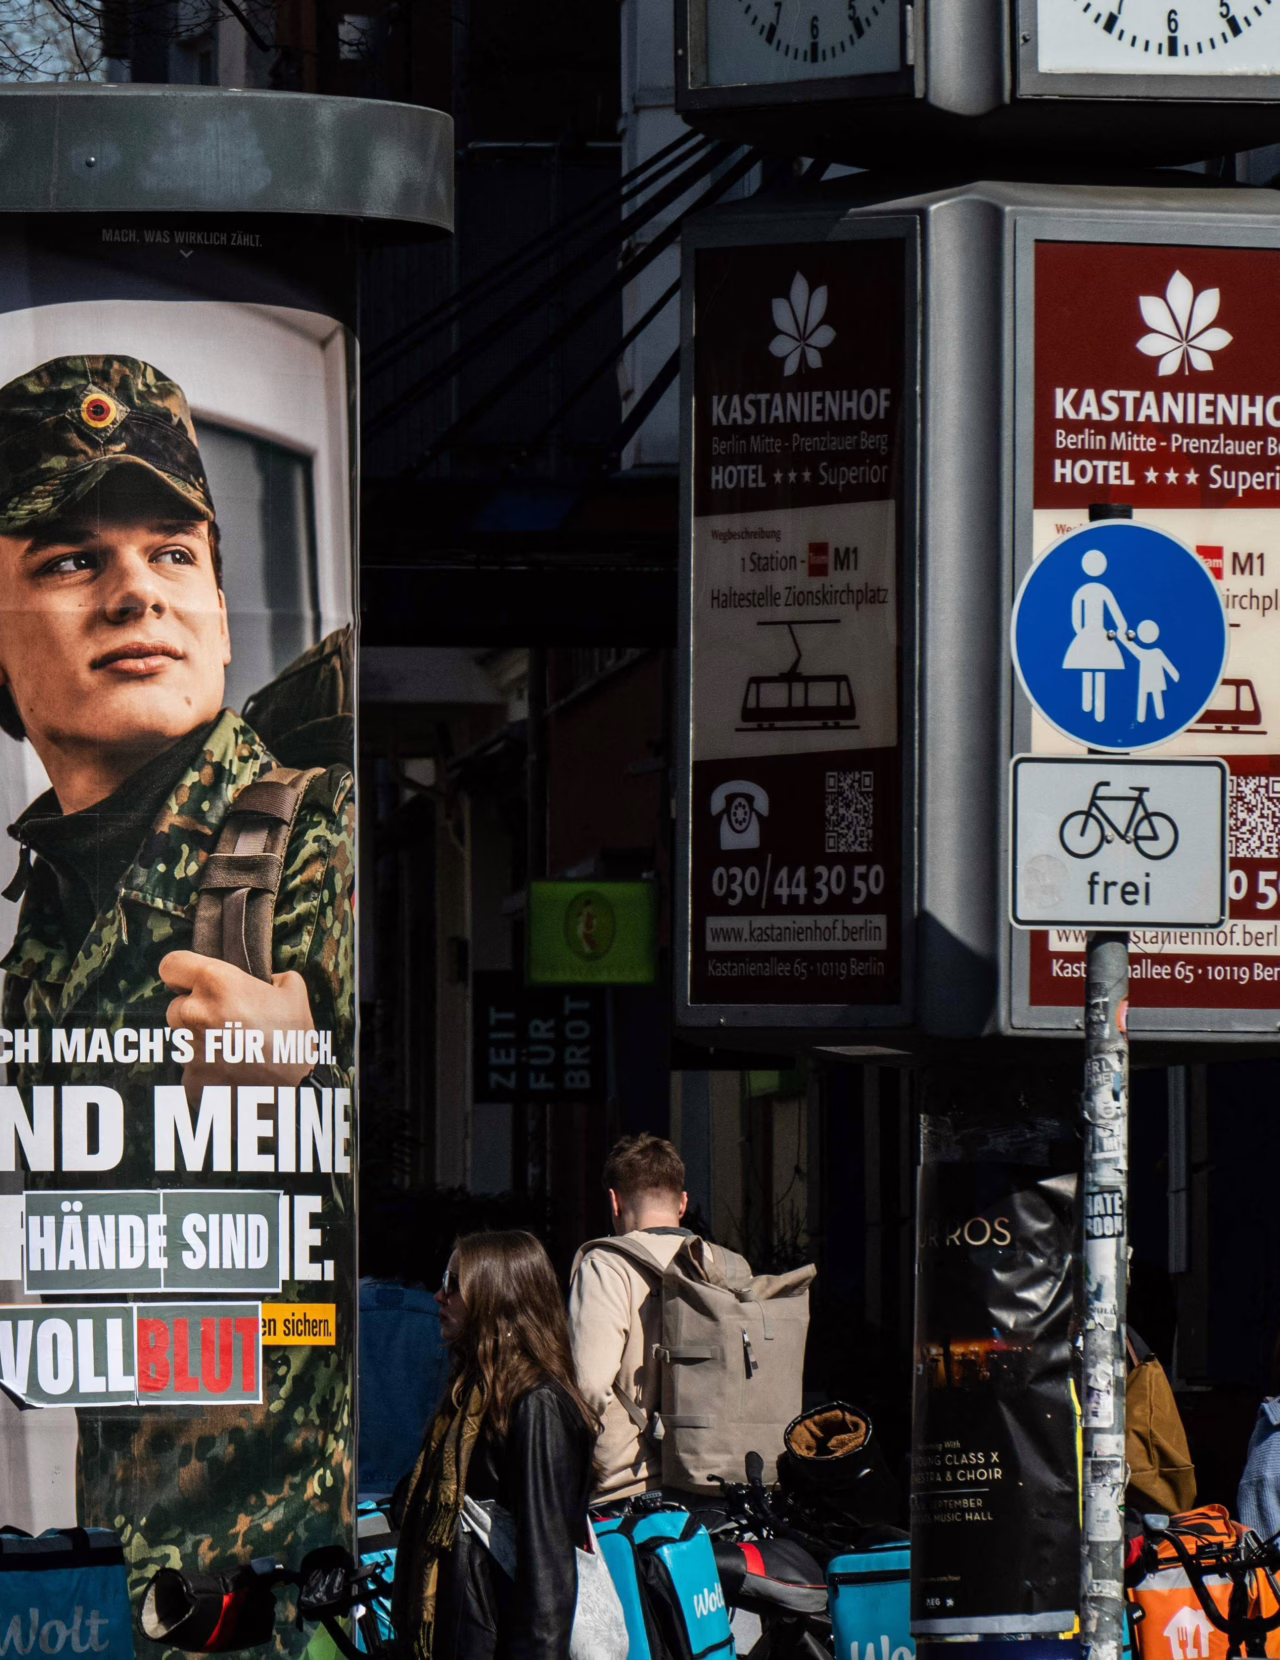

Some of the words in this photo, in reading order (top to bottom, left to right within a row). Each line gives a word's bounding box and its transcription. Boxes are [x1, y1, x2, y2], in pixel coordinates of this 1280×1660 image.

[1167, 9, 1179, 34] 6
[144, 229, 170, 244] WAS
[174, 230, 227, 246] WIRKLICH
[231, 230, 263, 248] ZÄHLT.
[711, 387, 892, 427] KASTANIENHOF
[711, 434, 747, 456] Berlin
[749, 433, 782, 454] Mitte
[792, 430, 858, 452] Prenzlauer
[860, 430, 889, 456] Berg
[1055, 428, 1107, 450] Berlin
[1110, 431, 1157, 452] Mitte
[1171, 432, 1264, 455] Prenzlauer
[710, 463, 766, 490] HOTEL
[818, 459, 889, 492] Superior
[1054, 458, 1136, 486] HOTEL
[749, 550, 797, 573] Station
[834, 546, 859, 571] M1
[1231, 551, 1265, 577] M1
[710, 584, 782, 609] Haltestelle
[784, 582, 889, 612] Zionskirchplatz
[813, 864, 847, 905] 30
[852, 863, 886, 905] 50
[1087, 871, 1151, 906] frei
[709, 918, 883, 943] www.kastanienhof.berlin
[708, 956, 792, 977] Kastanienallee
[793, 957, 808, 981] 65
[817, 961, 847, 981] 10119
[850, 956, 886, 977] Berlin
[1175, 961, 1195, 984] 65
[1206, 966, 1250, 985] 10119
[51, 1028, 195, 1064] MACH'S
[205, 1021, 265, 1064] FÜR
[272, 1029, 337, 1065] MICH.
[489, 1005, 517, 1091] ZEIT
[521, 1016, 556, 1091] FÜR
[563, 994, 593, 1090] BROT
[154, 1085, 351, 1174] MEINE
[27, 1200, 168, 1271] HÄNDE
[181, 1212, 269, 1271] SIND
[283, 1312, 333, 1338] sichern.
[945, 1451, 986, 1467] CLASS
[991, 1451, 1000, 1464] X
[956, 1467, 1003, 1481] CHOIR
[965, 1511, 994, 1522] HALL
